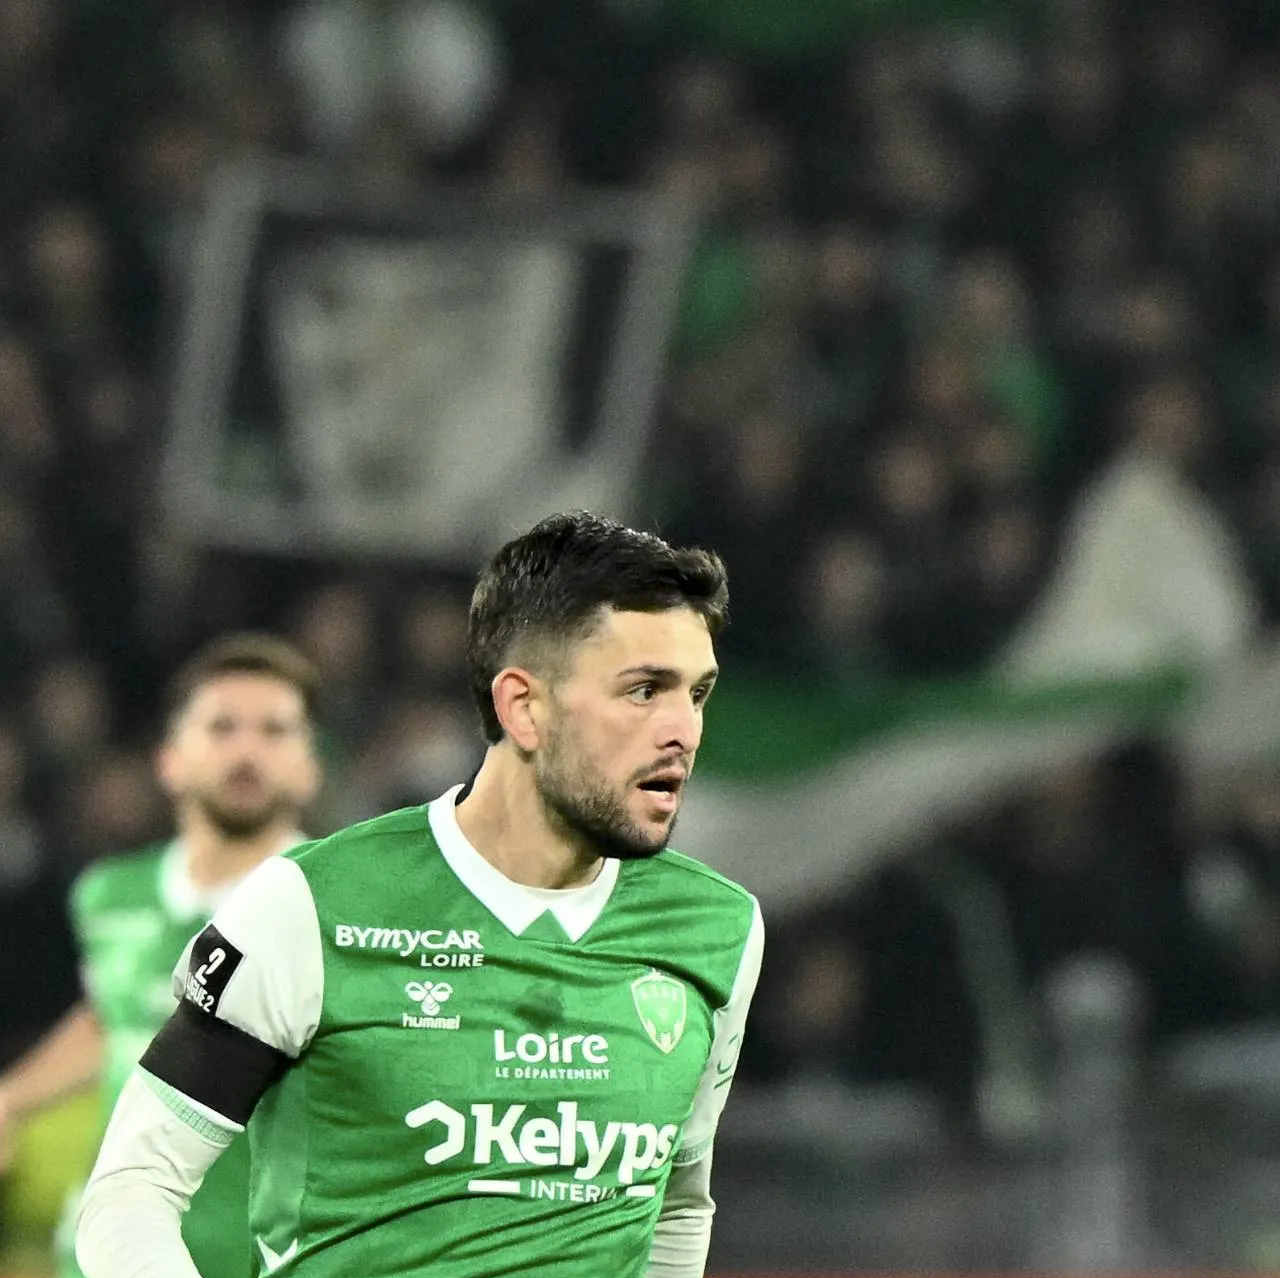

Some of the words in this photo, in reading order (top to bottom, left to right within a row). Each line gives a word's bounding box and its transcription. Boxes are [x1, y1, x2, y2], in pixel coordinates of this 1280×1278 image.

[195, 948, 226, 985] 2
[421, 954, 484, 967] LOIRE
[402, 1013, 461, 1029] hummel
[494, 1029, 609, 1064] Loire
[496, 1067, 509, 1078] LE
[514, 1066, 610, 1080] DÉPARTEMENT
[471, 1101, 678, 1184] Kelyps
